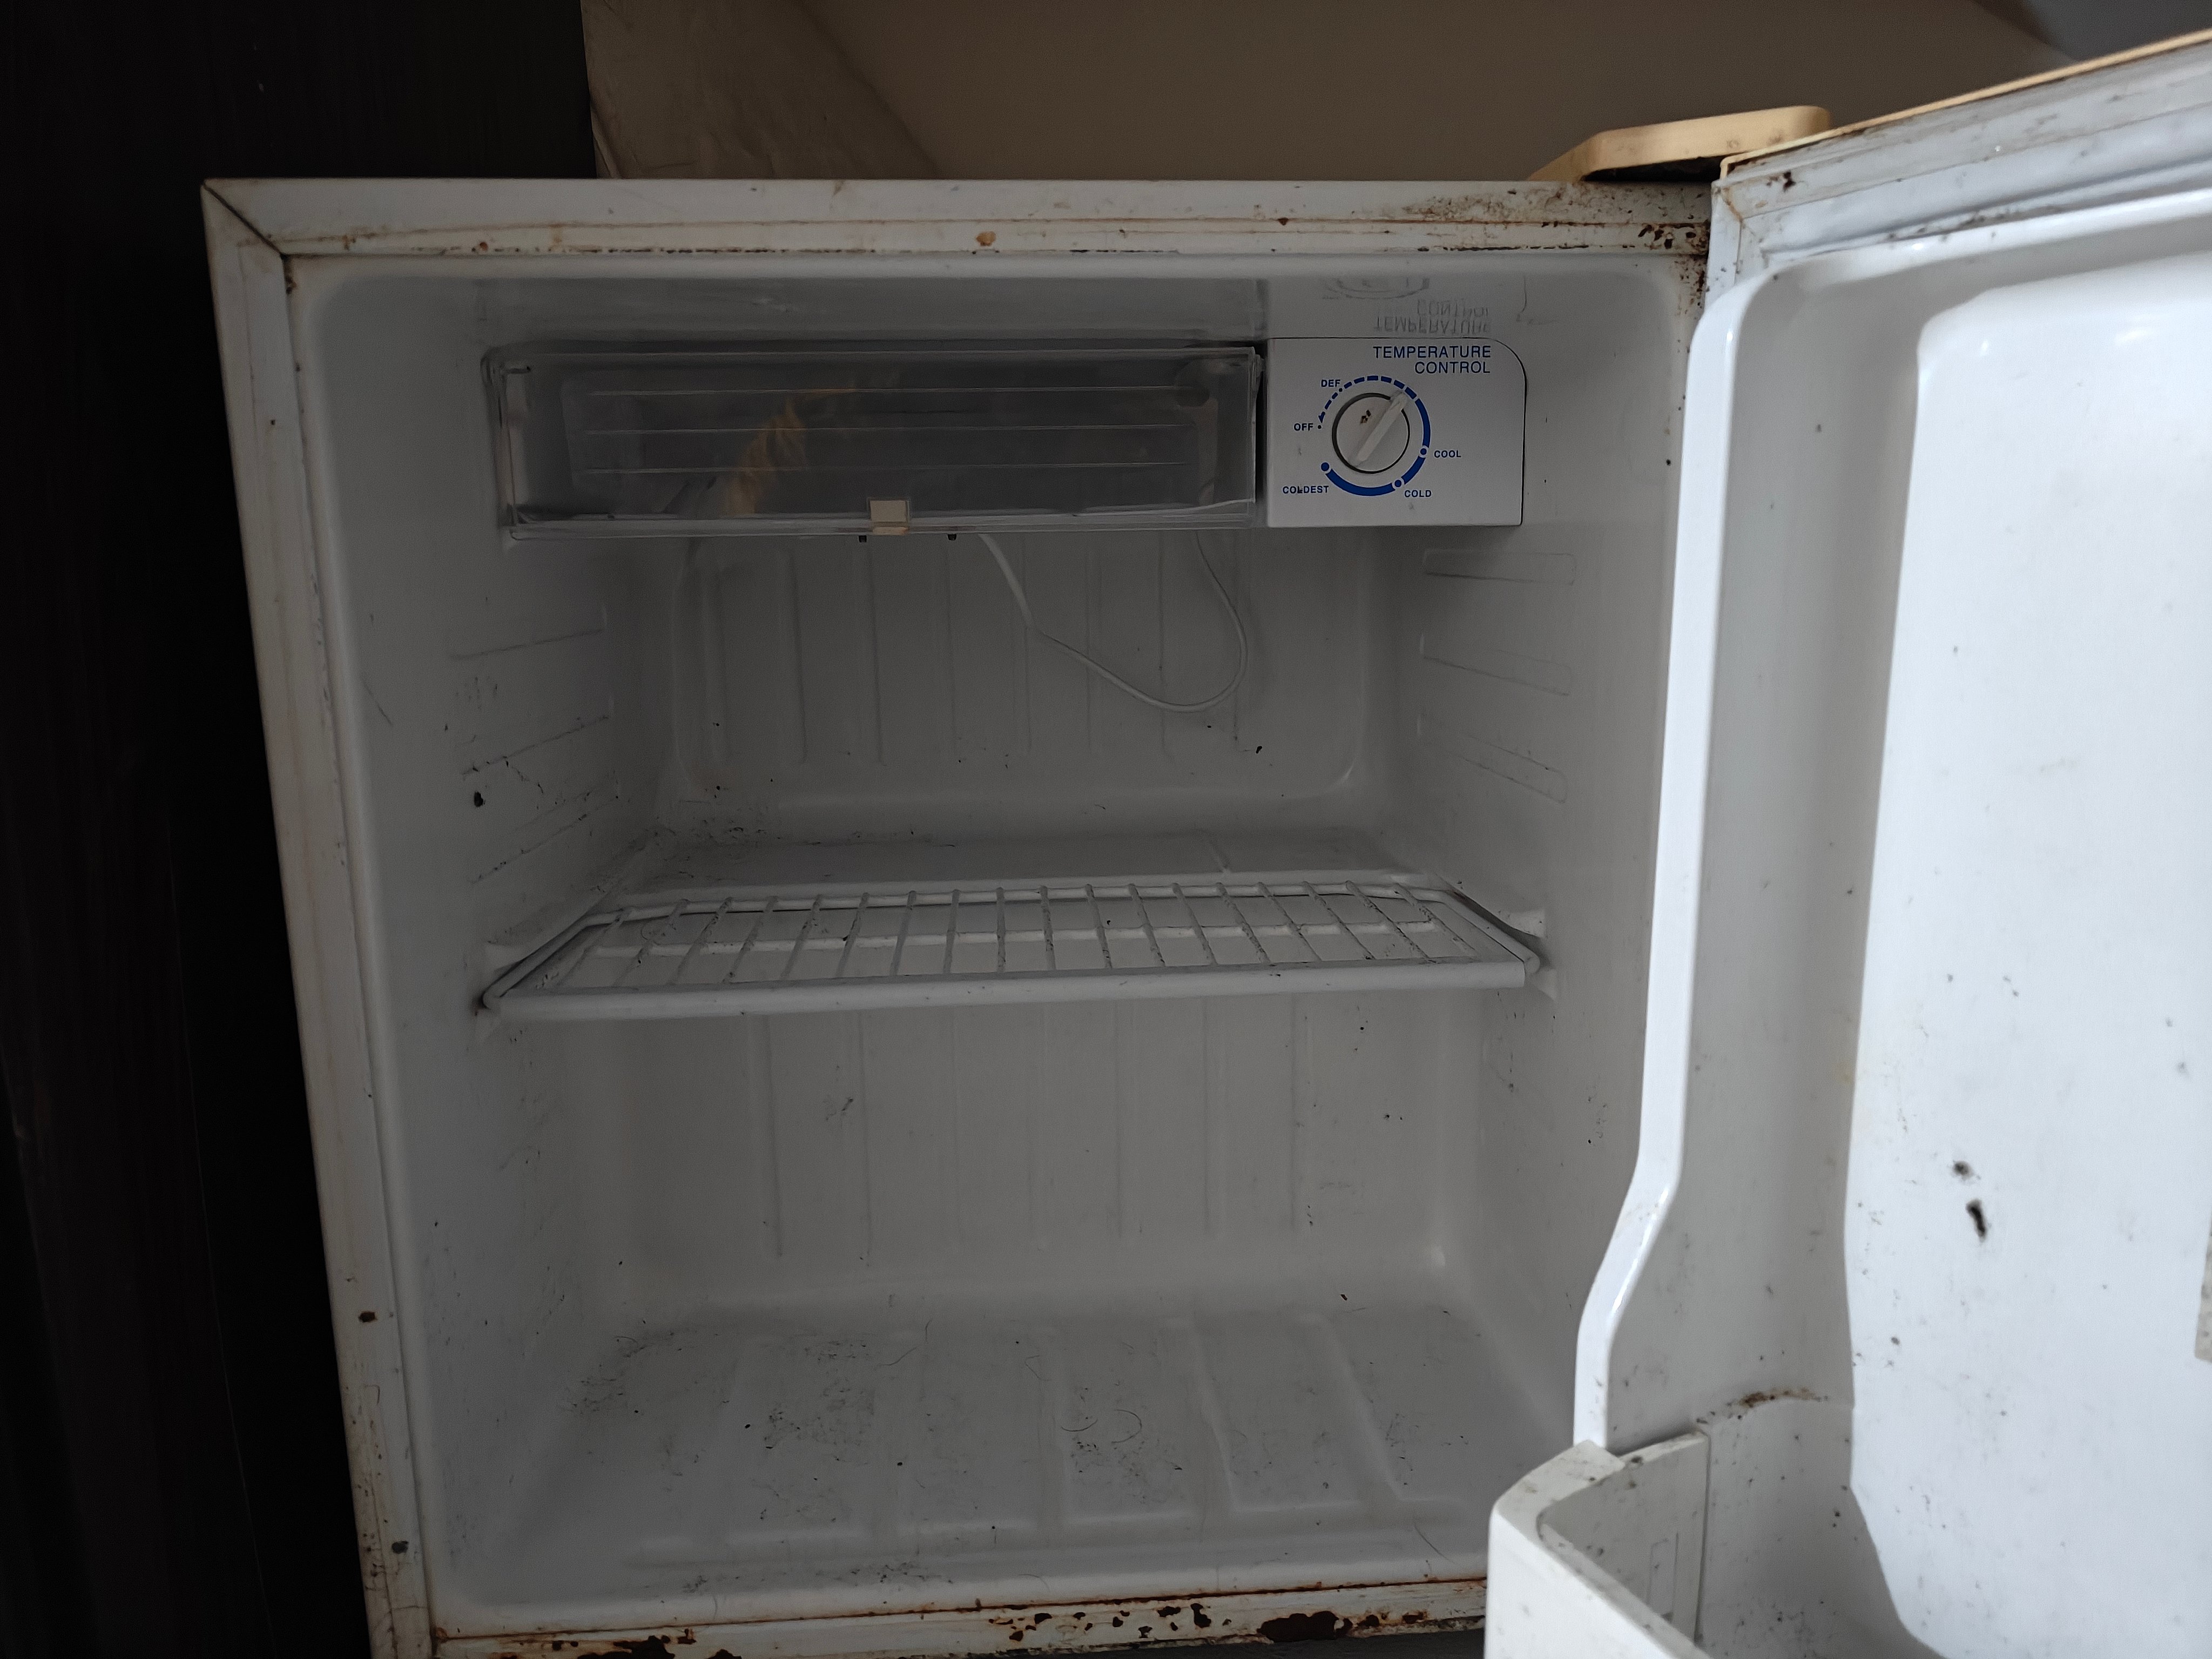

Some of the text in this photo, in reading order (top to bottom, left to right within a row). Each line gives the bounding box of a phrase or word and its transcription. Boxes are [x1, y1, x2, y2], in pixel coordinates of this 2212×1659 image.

[1373, 345, 1491, 359] TEMPERATURE
[1414, 361, 1491, 374] CONTROL
[1320, 379, 1340, 387] DEF
[1293, 423, 1314, 431] OFF
[1434, 450, 1461, 458] COOL
[1282, 485, 1329, 494] COLDEST
[1404, 490, 1432, 498] COLD
